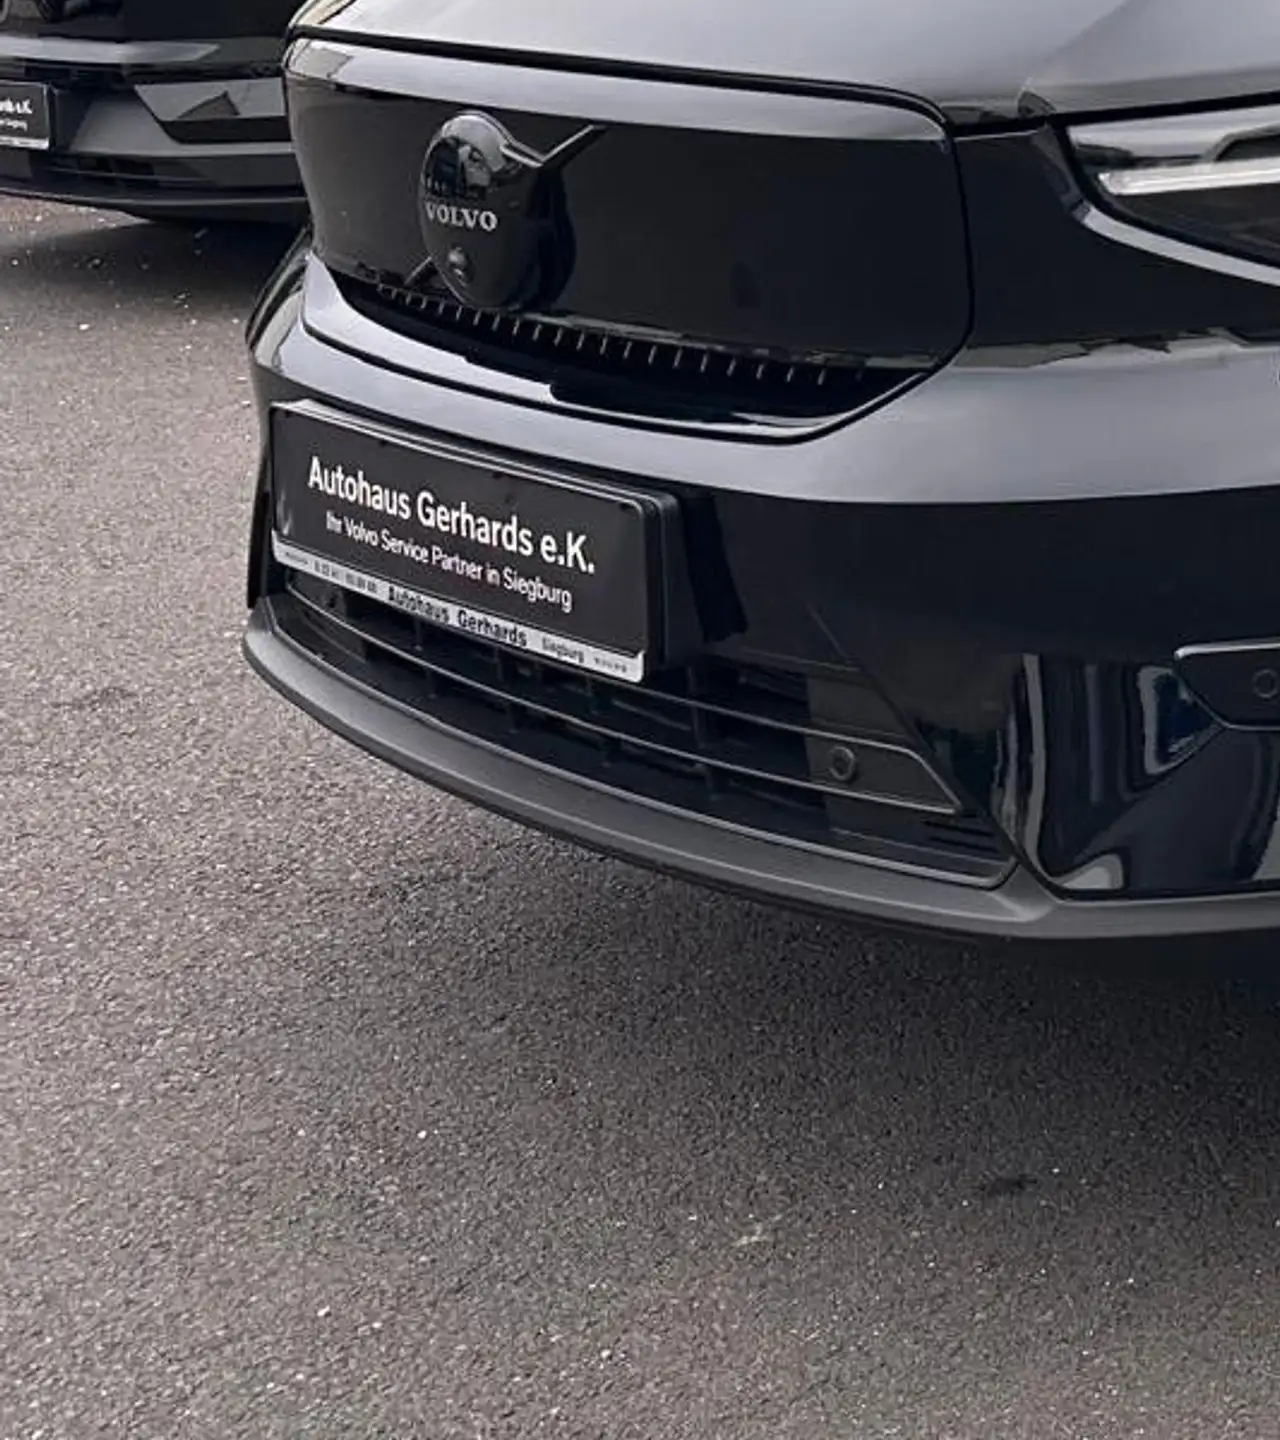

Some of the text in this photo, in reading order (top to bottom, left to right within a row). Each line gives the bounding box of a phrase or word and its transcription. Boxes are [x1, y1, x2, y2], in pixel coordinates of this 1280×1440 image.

[424, 201, 498, 232] VOLVO
[308, 456, 596, 574] Autohaus Gerhards e.K.
[343, 515, 379, 547] Volvo
[381, 528, 429, 562] Service
[431, 545, 483, 581] Partner
[486, 563, 500, 586] in
[503, 566, 573, 613] Siegburg
[387, 585, 528, 648] Autohaus Gerhards
